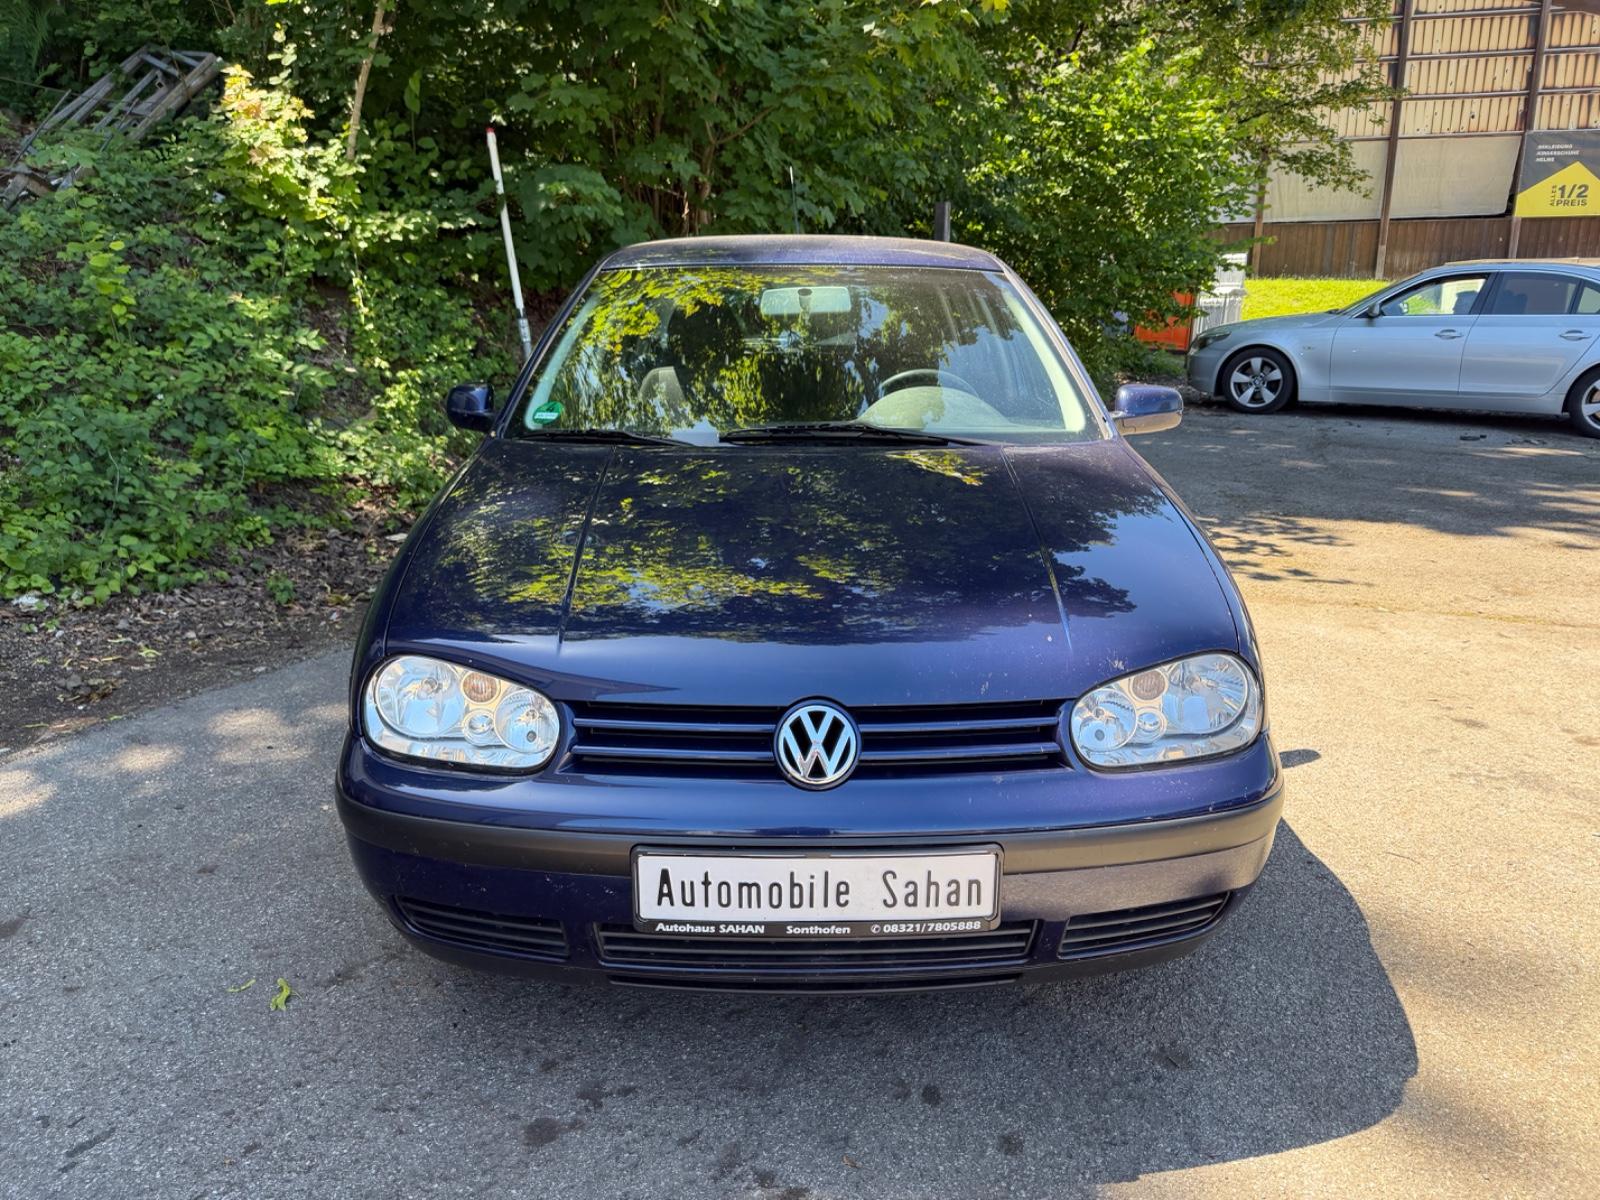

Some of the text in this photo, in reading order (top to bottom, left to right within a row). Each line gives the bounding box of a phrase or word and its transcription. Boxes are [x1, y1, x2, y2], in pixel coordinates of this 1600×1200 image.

[1558, 184, 1589, 198] 1/2
[1556, 199, 1588, 207] PREIS
[657, 868, 982, 909] Automobile Sahan
[655, 921, 981, 934] Autohaus SAHAN Sonthofen 08321/7805888
